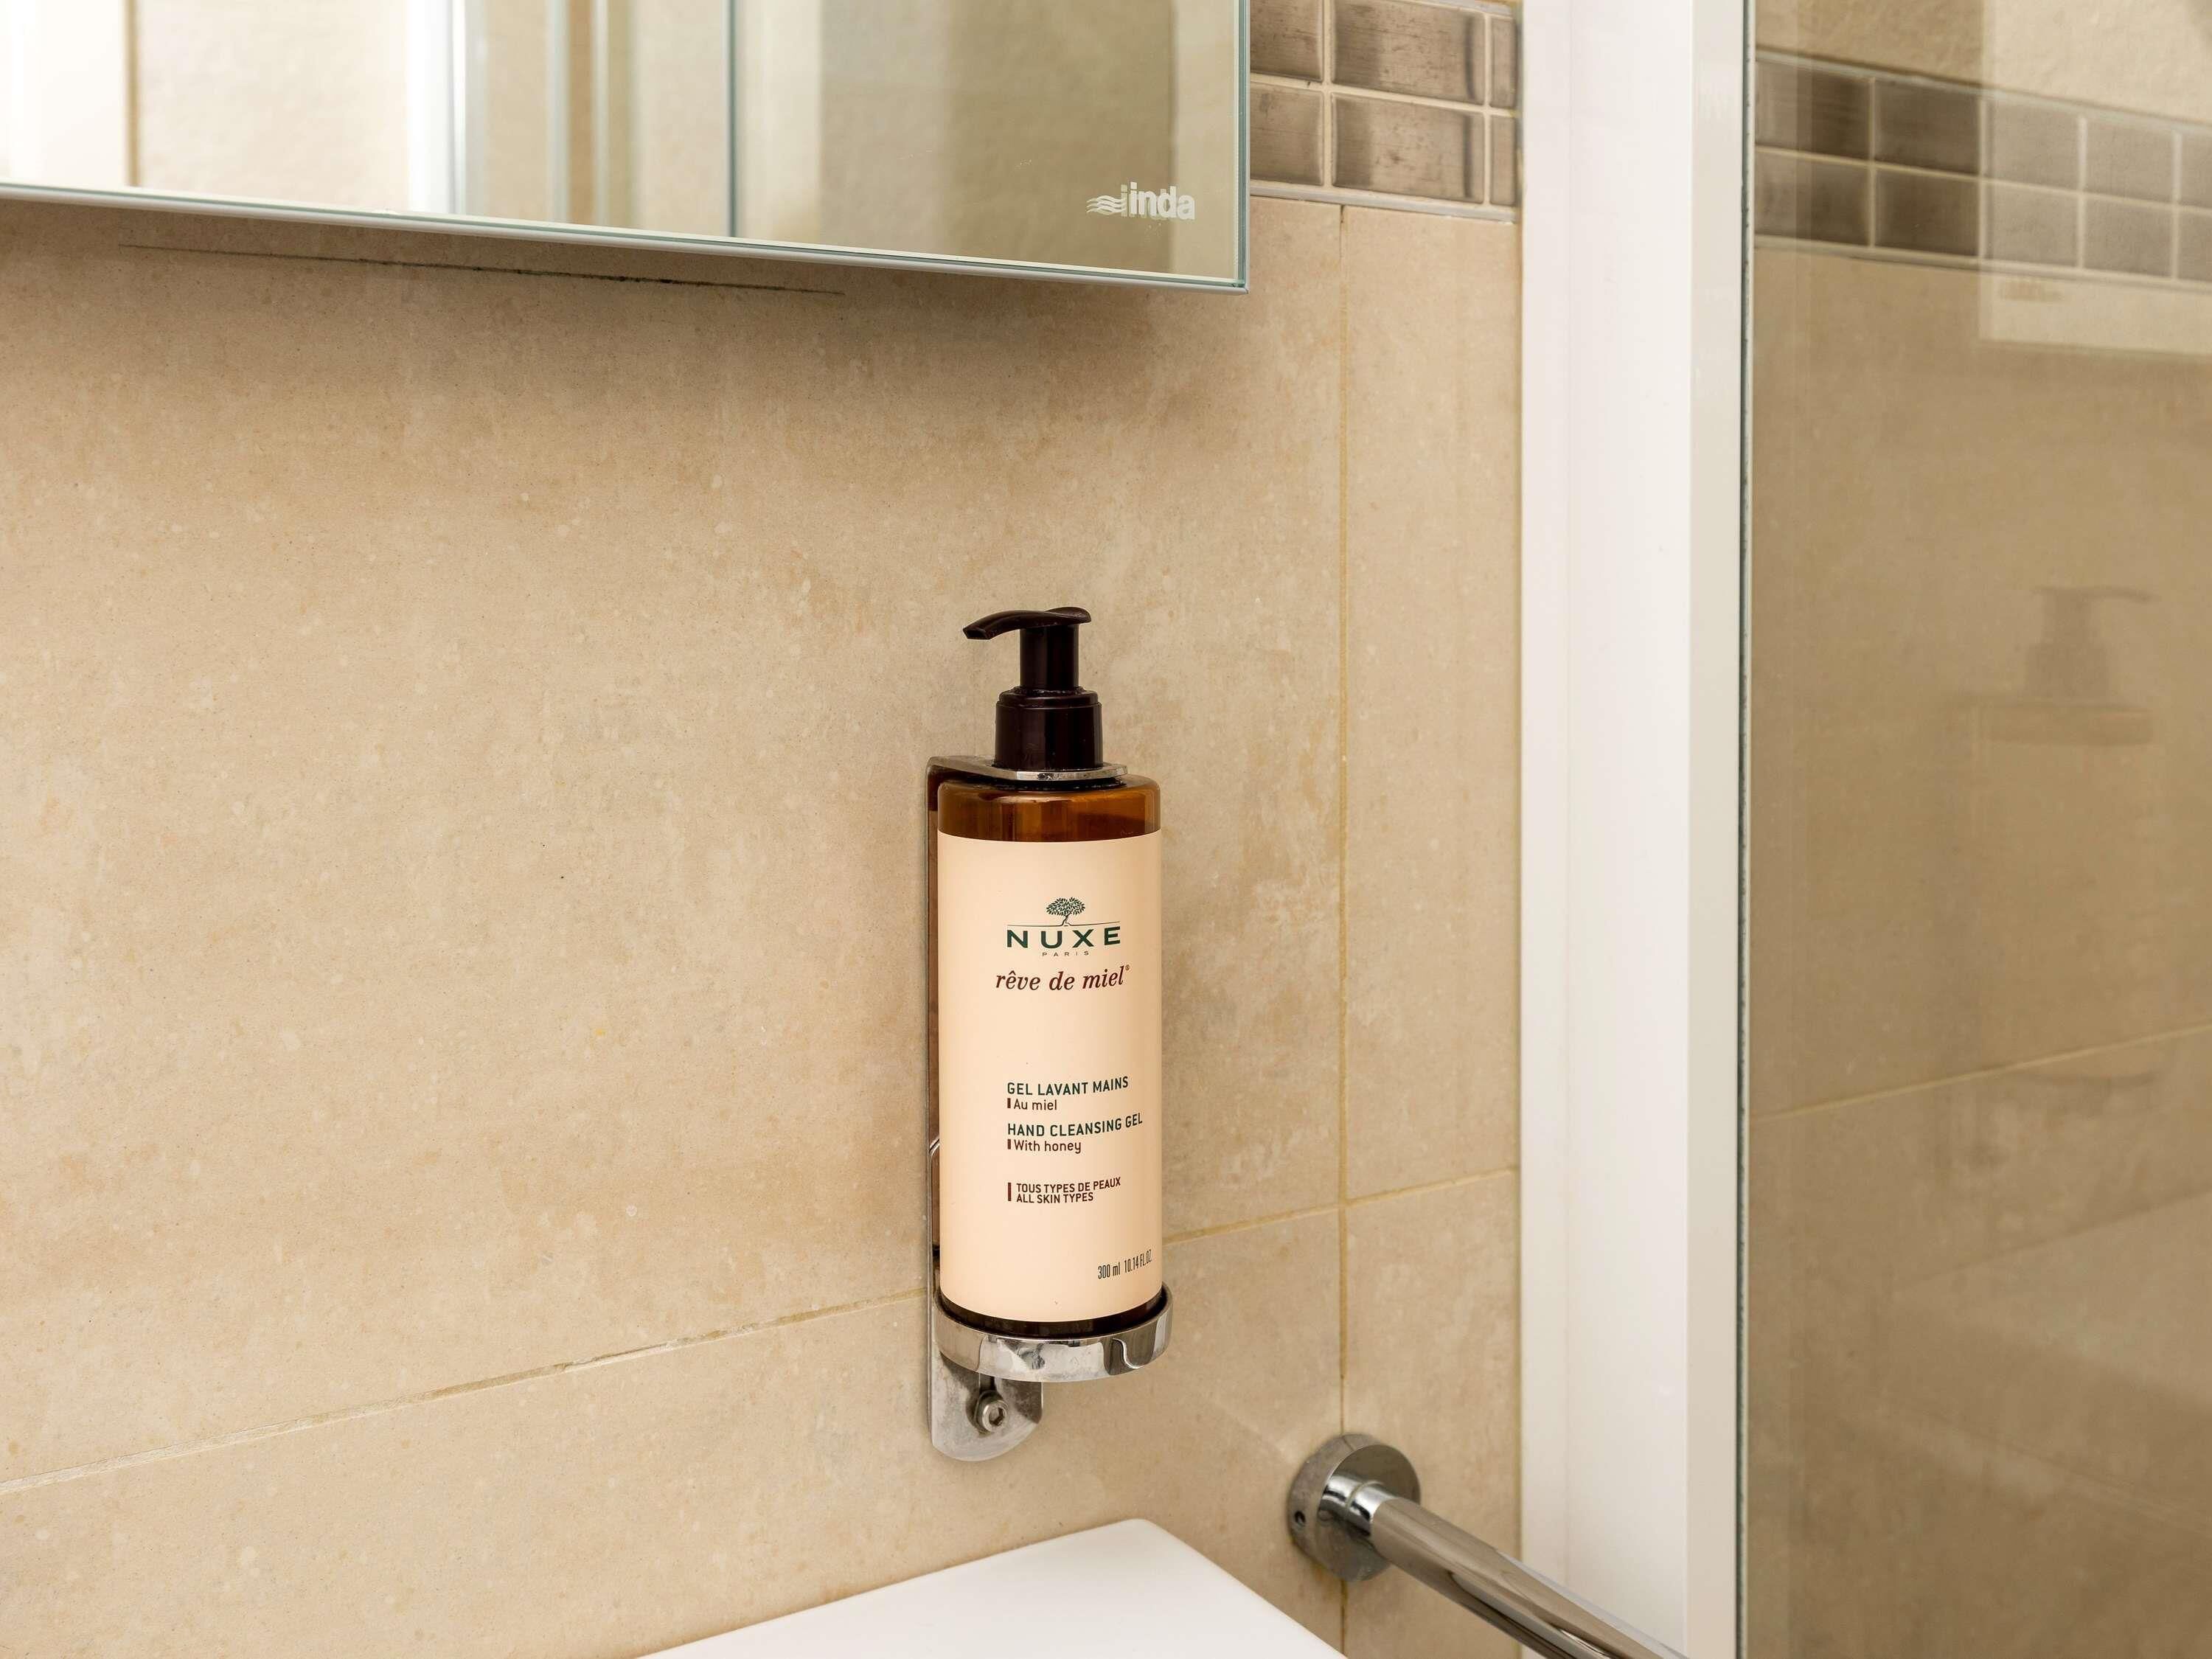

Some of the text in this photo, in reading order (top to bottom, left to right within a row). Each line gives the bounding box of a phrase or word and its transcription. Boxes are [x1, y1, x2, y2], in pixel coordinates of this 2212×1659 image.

[1006, 926, 1121, 949] NUXE
[996, 970, 1041, 991] rêve
[1048, 970, 1076, 991] de
[1007, 1075, 1129, 1096] GEL LAVANT MAINS
[1014, 1098, 1058, 1111] Au miel
[1007, 1112, 1143, 1137] HAND CLEANSING GEL
[1014, 1138, 1082, 1155] With honey
[1016, 1176, 1121, 1194] TOUS TYPES DE PEAUX
[1016, 1192, 1094, 1204] ALL SKIN TYPES
[1097, 1264, 1111, 1279] 300
[1112, 1262, 1121, 1277] ml
